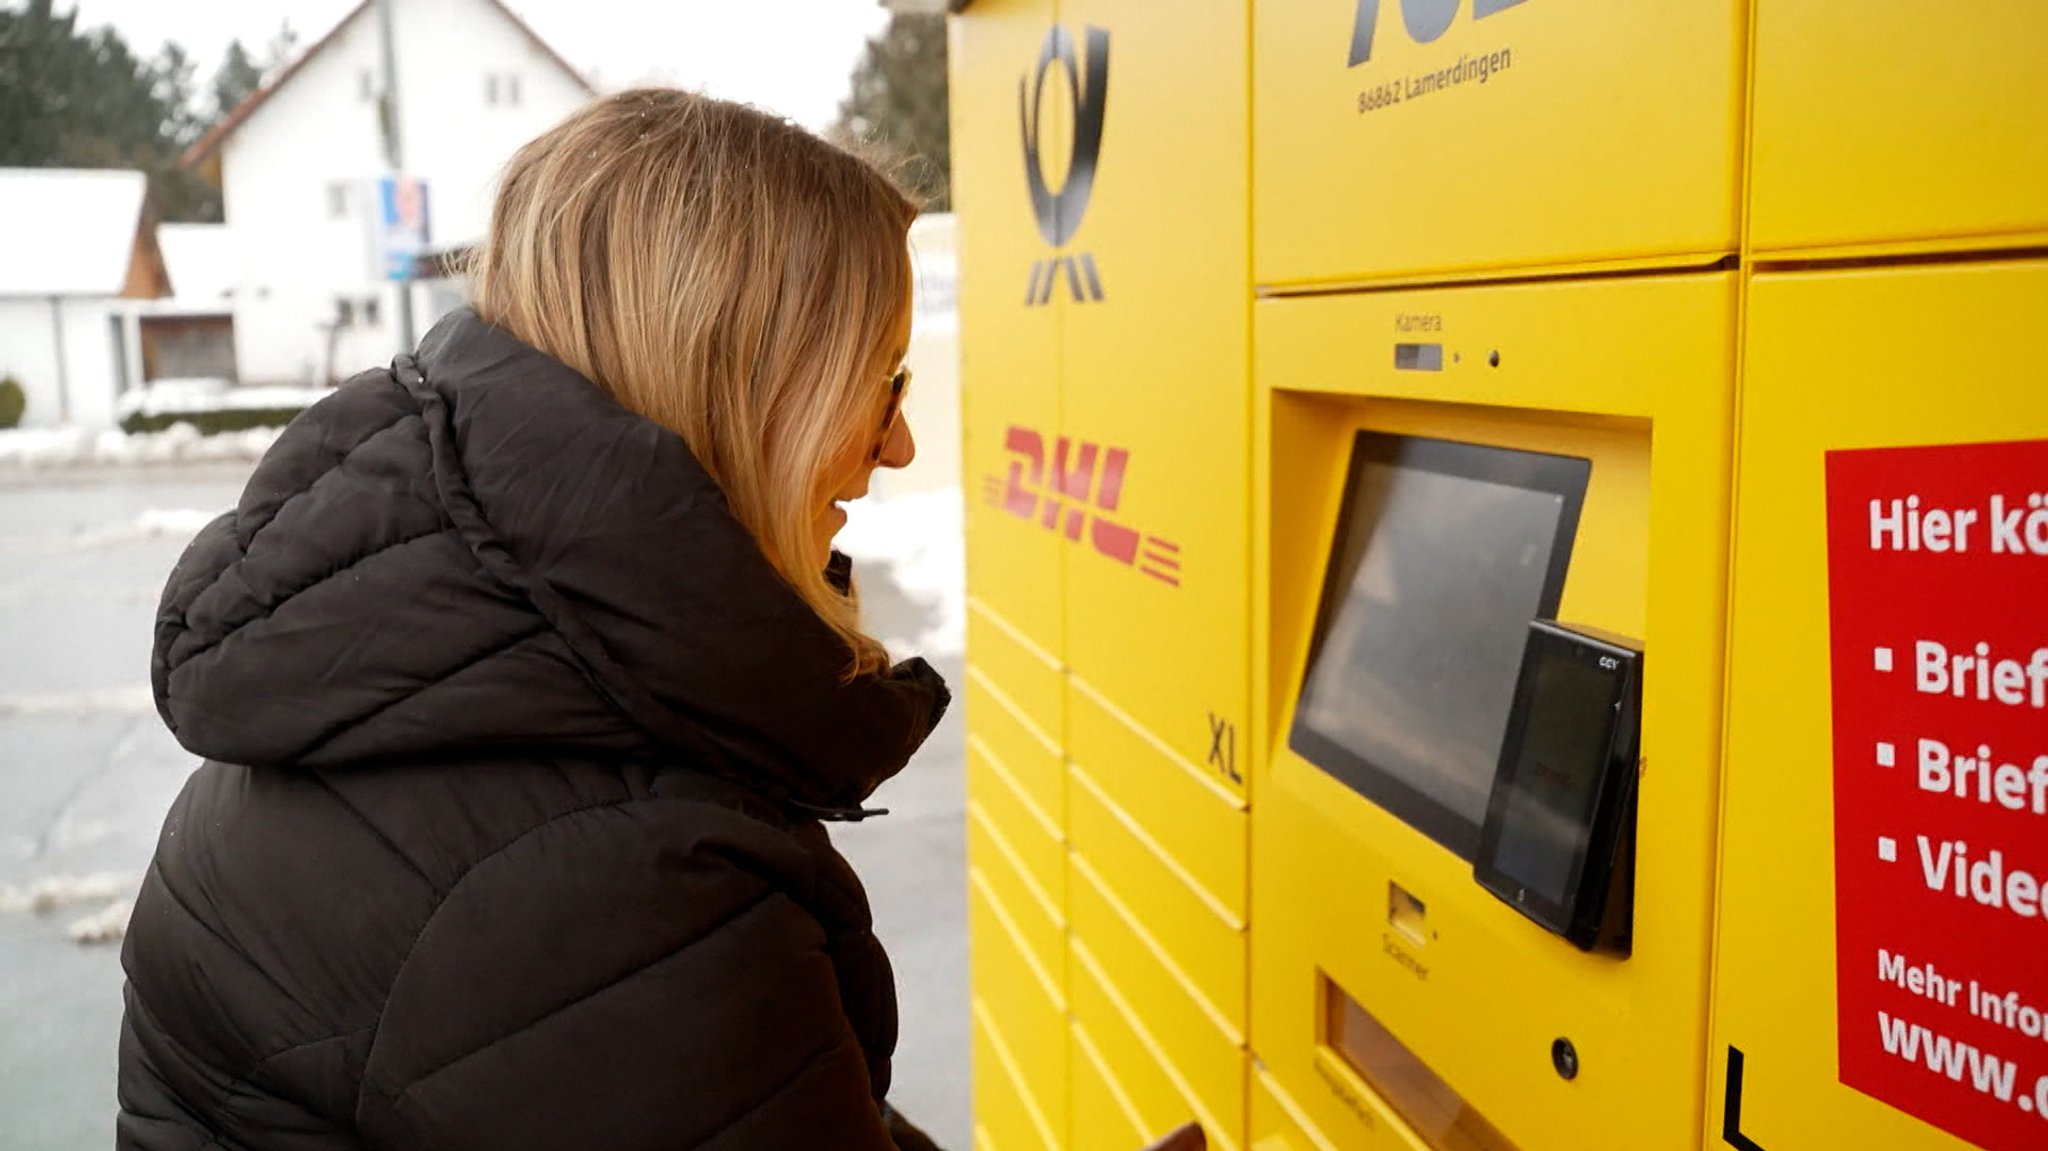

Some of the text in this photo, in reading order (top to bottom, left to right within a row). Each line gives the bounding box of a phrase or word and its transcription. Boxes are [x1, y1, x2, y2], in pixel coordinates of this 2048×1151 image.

[1358, 48, 1512, 115] 86862 Lamerdingen
[1395, 312, 1443, 333] Kamera
[1003, 424, 1141, 567] DHL
[1869, 495, 1977, 553] Hier
[1916, 639, 2048, 709] Brief
[1207, 709, 1243, 786] XL
[1918, 737, 2048, 815] Brief
[1917, 835, 2048, 921] Vide
[1878, 948, 1962, 1007] Mehr
